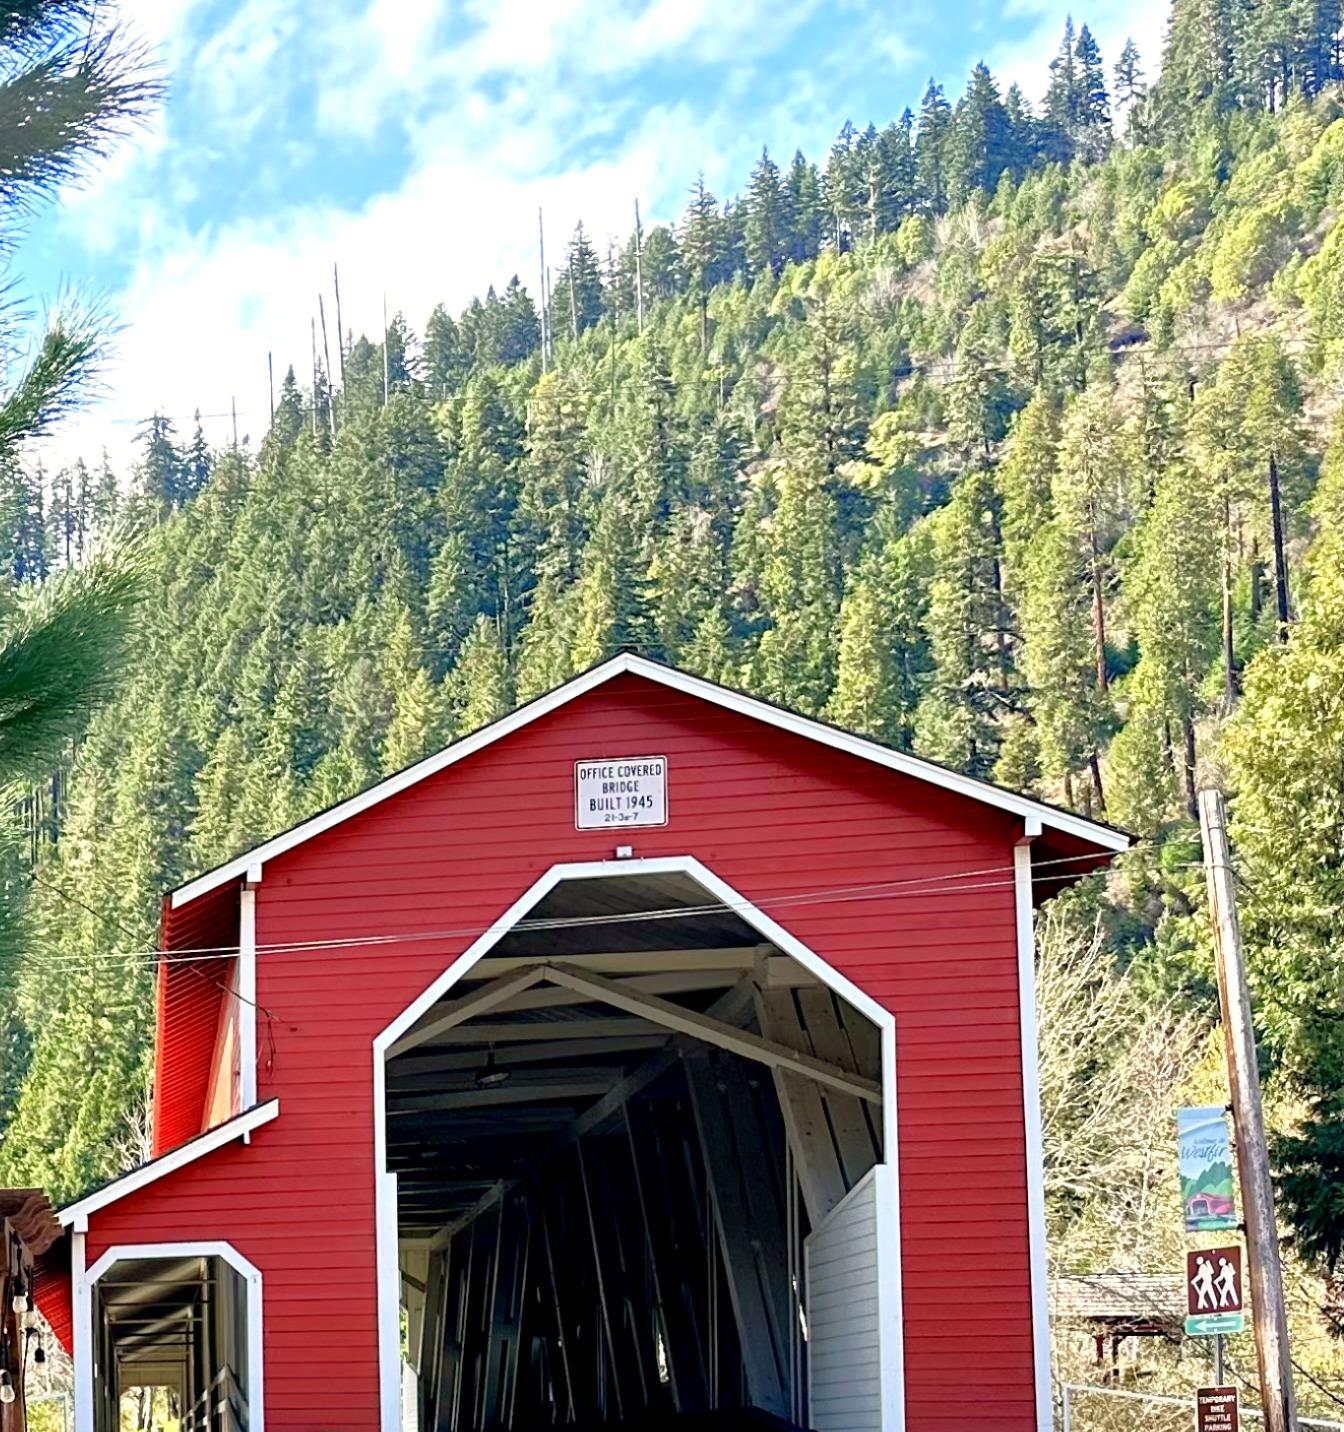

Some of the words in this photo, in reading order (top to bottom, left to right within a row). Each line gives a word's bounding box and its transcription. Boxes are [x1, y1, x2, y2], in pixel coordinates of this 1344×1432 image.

[580, 767, 614, 780] OFFICE
[617, 764, 662, 778] COVERED
[602, 780, 640, 794] BRIDGE
[589, 796, 622, 812] BUILT
[626, 794, 653, 810] 1945
